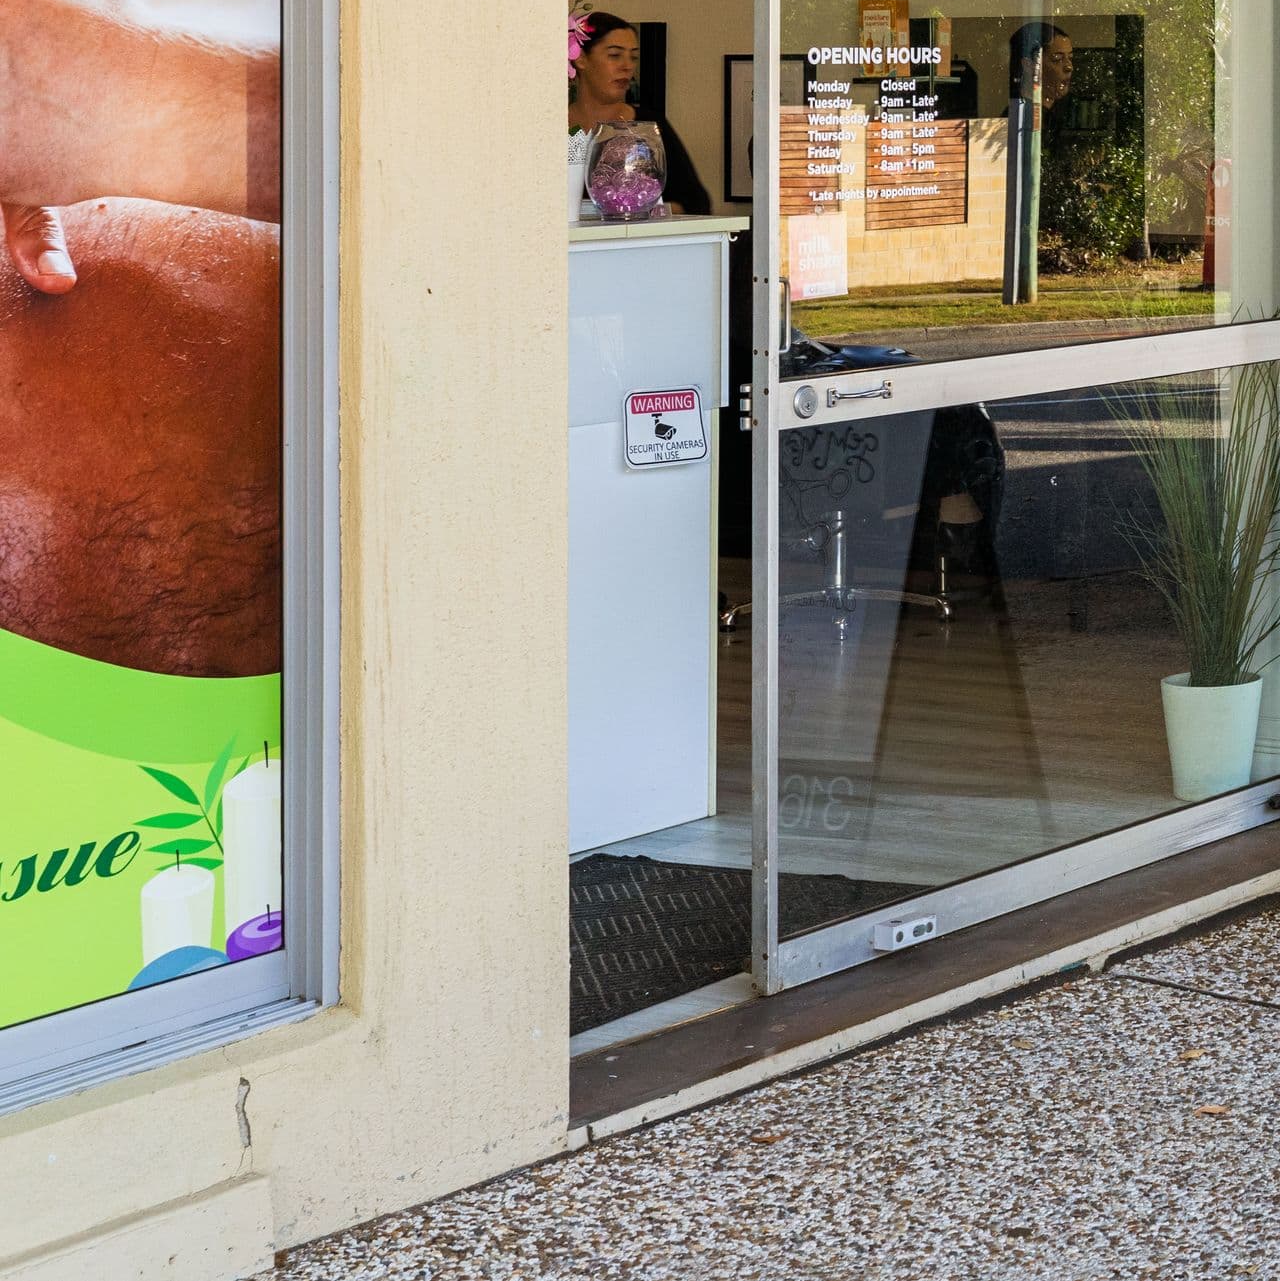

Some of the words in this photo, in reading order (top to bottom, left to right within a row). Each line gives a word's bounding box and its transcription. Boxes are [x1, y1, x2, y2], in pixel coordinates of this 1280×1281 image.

[807, 47, 883, 65] OPENING
[886, 46, 942, 65] HOURS
[807, 80, 850, 94] Monday
[881, 79, 916, 92] Closed
[807, 97, 852, 111] Tuesday
[881, 96, 904, 108] 9am
[807, 113, 870, 126] Wednesday
[881, 112, 904, 124] 9am
[807, 130, 857, 143] Thursday
[881, 128, 904, 140] 9am
[807, 146, 842, 160] Friday
[881, 144, 904, 156] 9am
[807, 162, 855, 176] Saturday
[881, 160, 904, 172] 8am
[835, 188, 866, 201] nights
[867, 187, 878, 200] by
[880, 184, 941, 199] appointment.
[633, 395, 692, 412] WARNING
[629, 443, 664, 454] SECURITY
[666, 439, 704, 452] CAMERAS
[655, 452, 662, 460] IN
[665, 451, 680, 460] USE
[0, 830, 142, 902] sue
